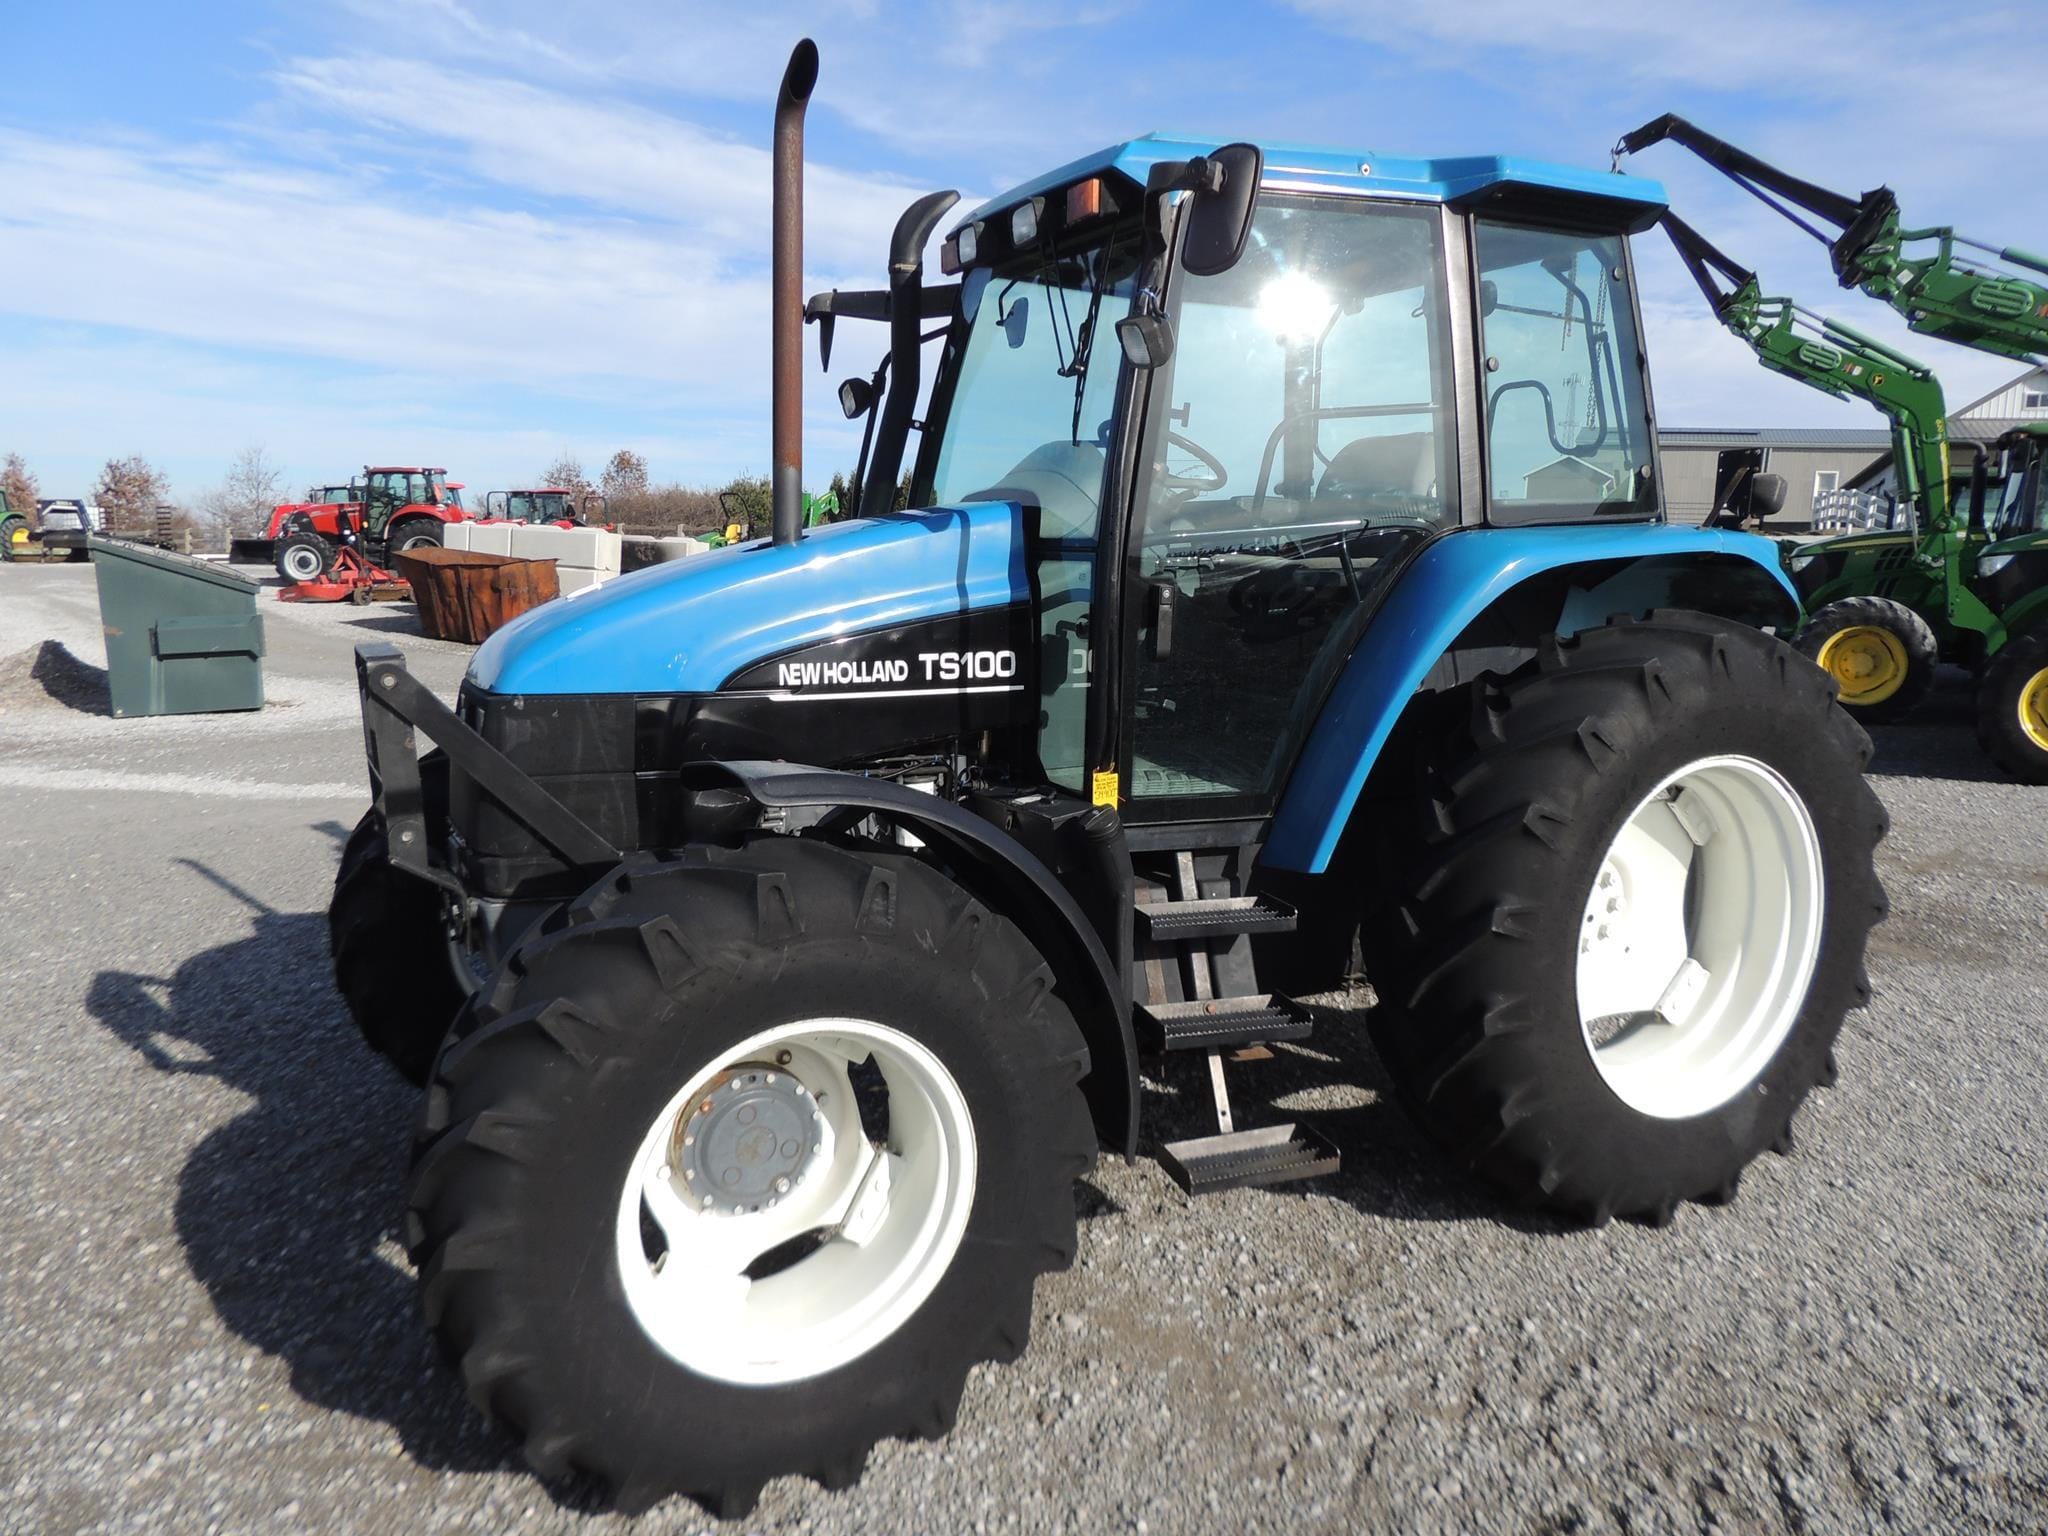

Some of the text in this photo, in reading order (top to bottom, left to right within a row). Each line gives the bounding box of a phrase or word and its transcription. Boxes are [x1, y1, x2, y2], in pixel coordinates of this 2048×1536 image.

[778, 650, 1016, 686] NEW HOLLAND TS100
